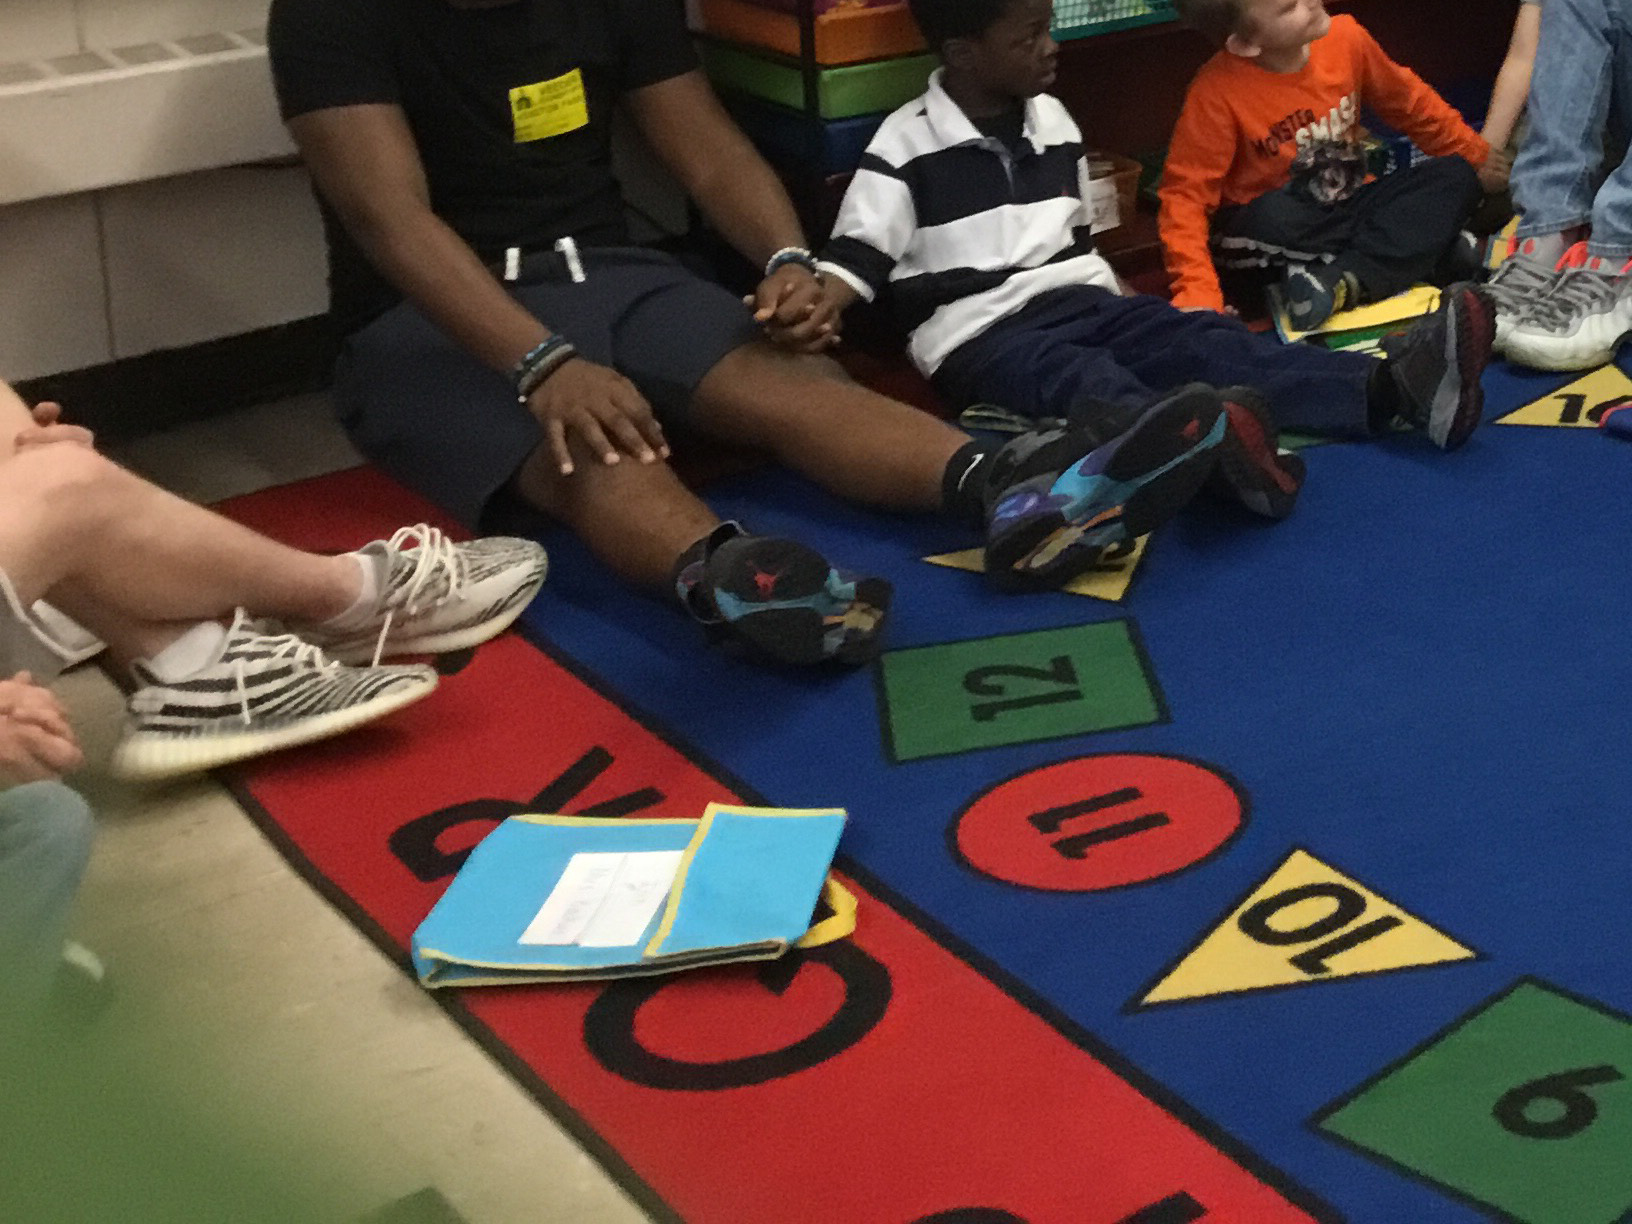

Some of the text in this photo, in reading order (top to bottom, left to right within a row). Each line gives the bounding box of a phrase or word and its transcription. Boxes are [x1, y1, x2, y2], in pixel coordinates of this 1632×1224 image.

[961, 654, 1085, 723] 12
[1025, 782, 1170, 862] 11
[1235, 880, 1405, 976] 10
